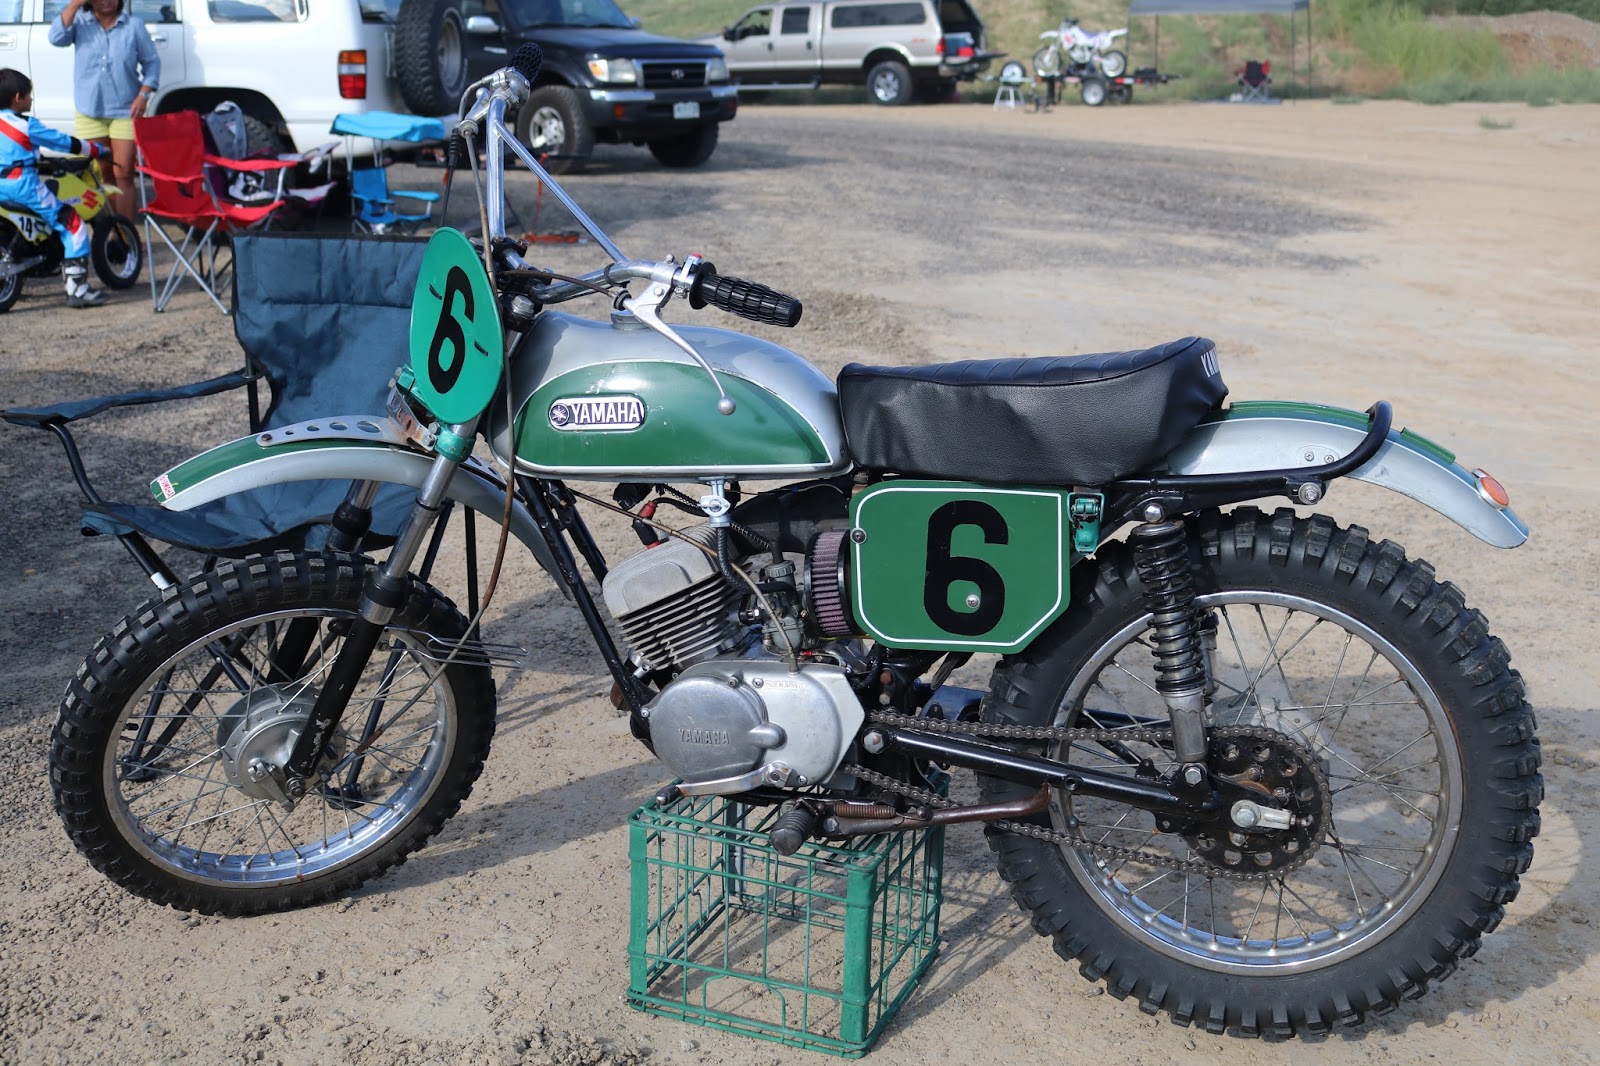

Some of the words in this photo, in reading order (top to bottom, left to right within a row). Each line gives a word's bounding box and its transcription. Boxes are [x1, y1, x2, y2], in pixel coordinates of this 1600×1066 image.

[428, 265, 475, 394] 6
[571, 401, 640, 424] YAMAHA
[923, 499, 1009, 637] 6
[677, 727, 730, 745] YAMAHA
